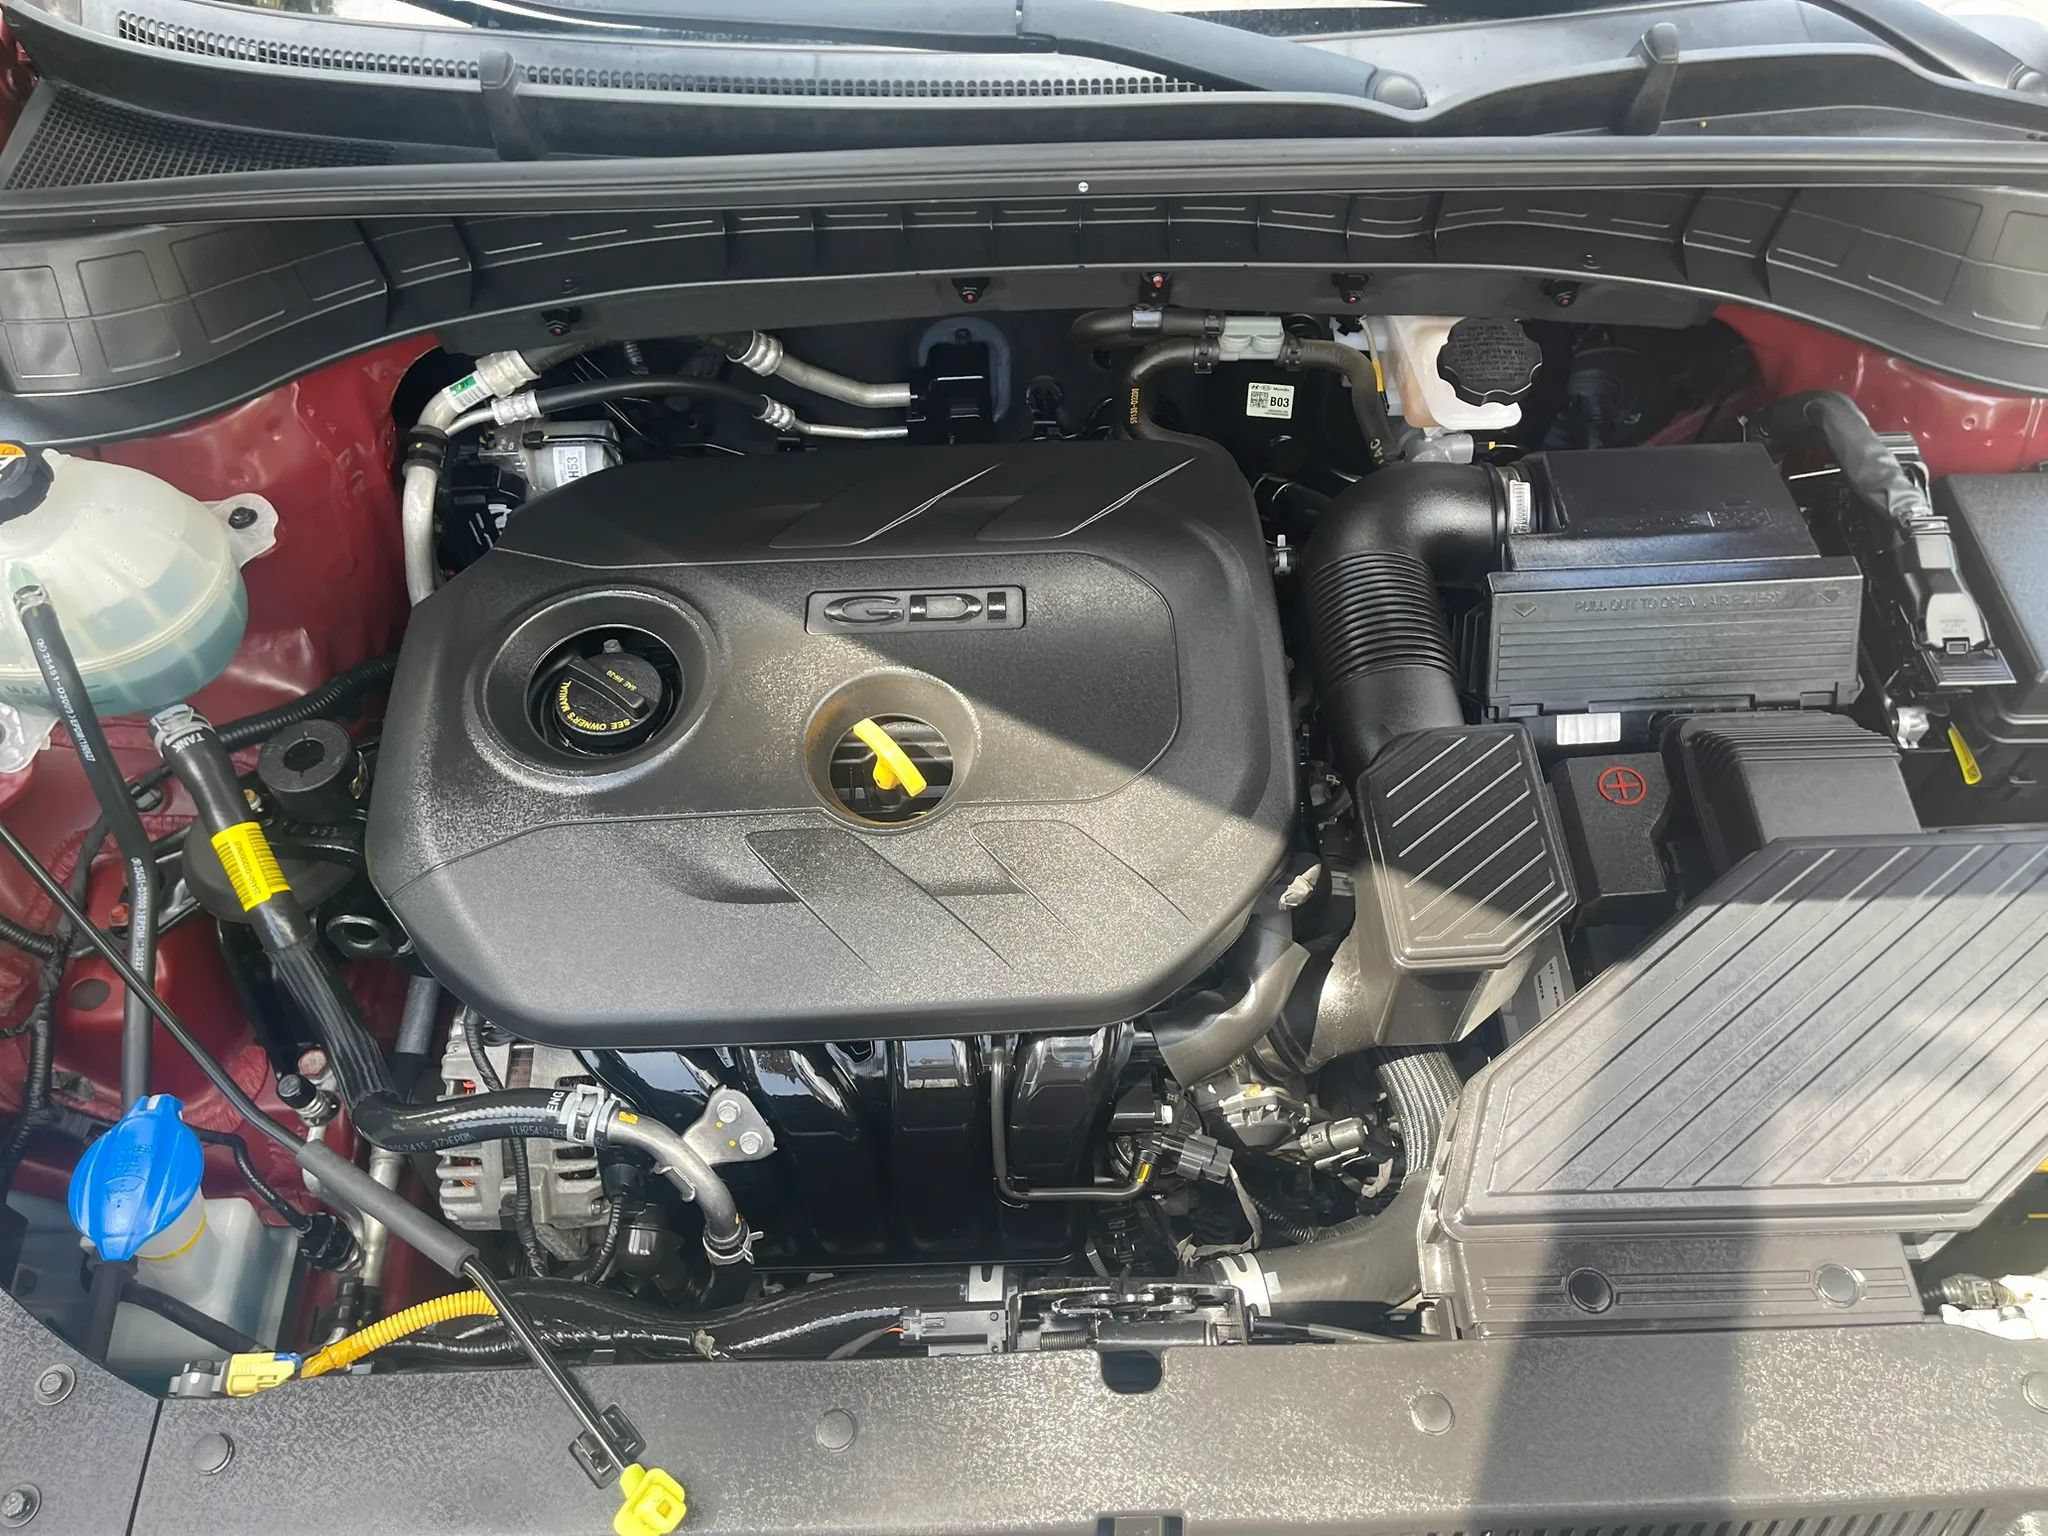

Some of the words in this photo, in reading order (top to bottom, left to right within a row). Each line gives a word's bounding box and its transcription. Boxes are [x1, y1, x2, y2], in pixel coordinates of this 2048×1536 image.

[1270, 396, 1290, 408] B03
[566, 456, 579, 478] H53
[823, 591, 1007, 624] GDI
[1574, 600, 1608, 613] PULL
[1611, 599, 1636, 611] OUT
[1639, 597, 1658, 609] TO
[1660, 596, 1697, 609] OPEN
[559, 680, 572, 713] MANUAL
[623, 680, 637, 692] SAE
[566, 711, 607, 731] OWNER'S
[610, 718, 631, 731] SEE
[171, 732, 205, 754] TANK
[545, 1091, 565, 1113] ENG
